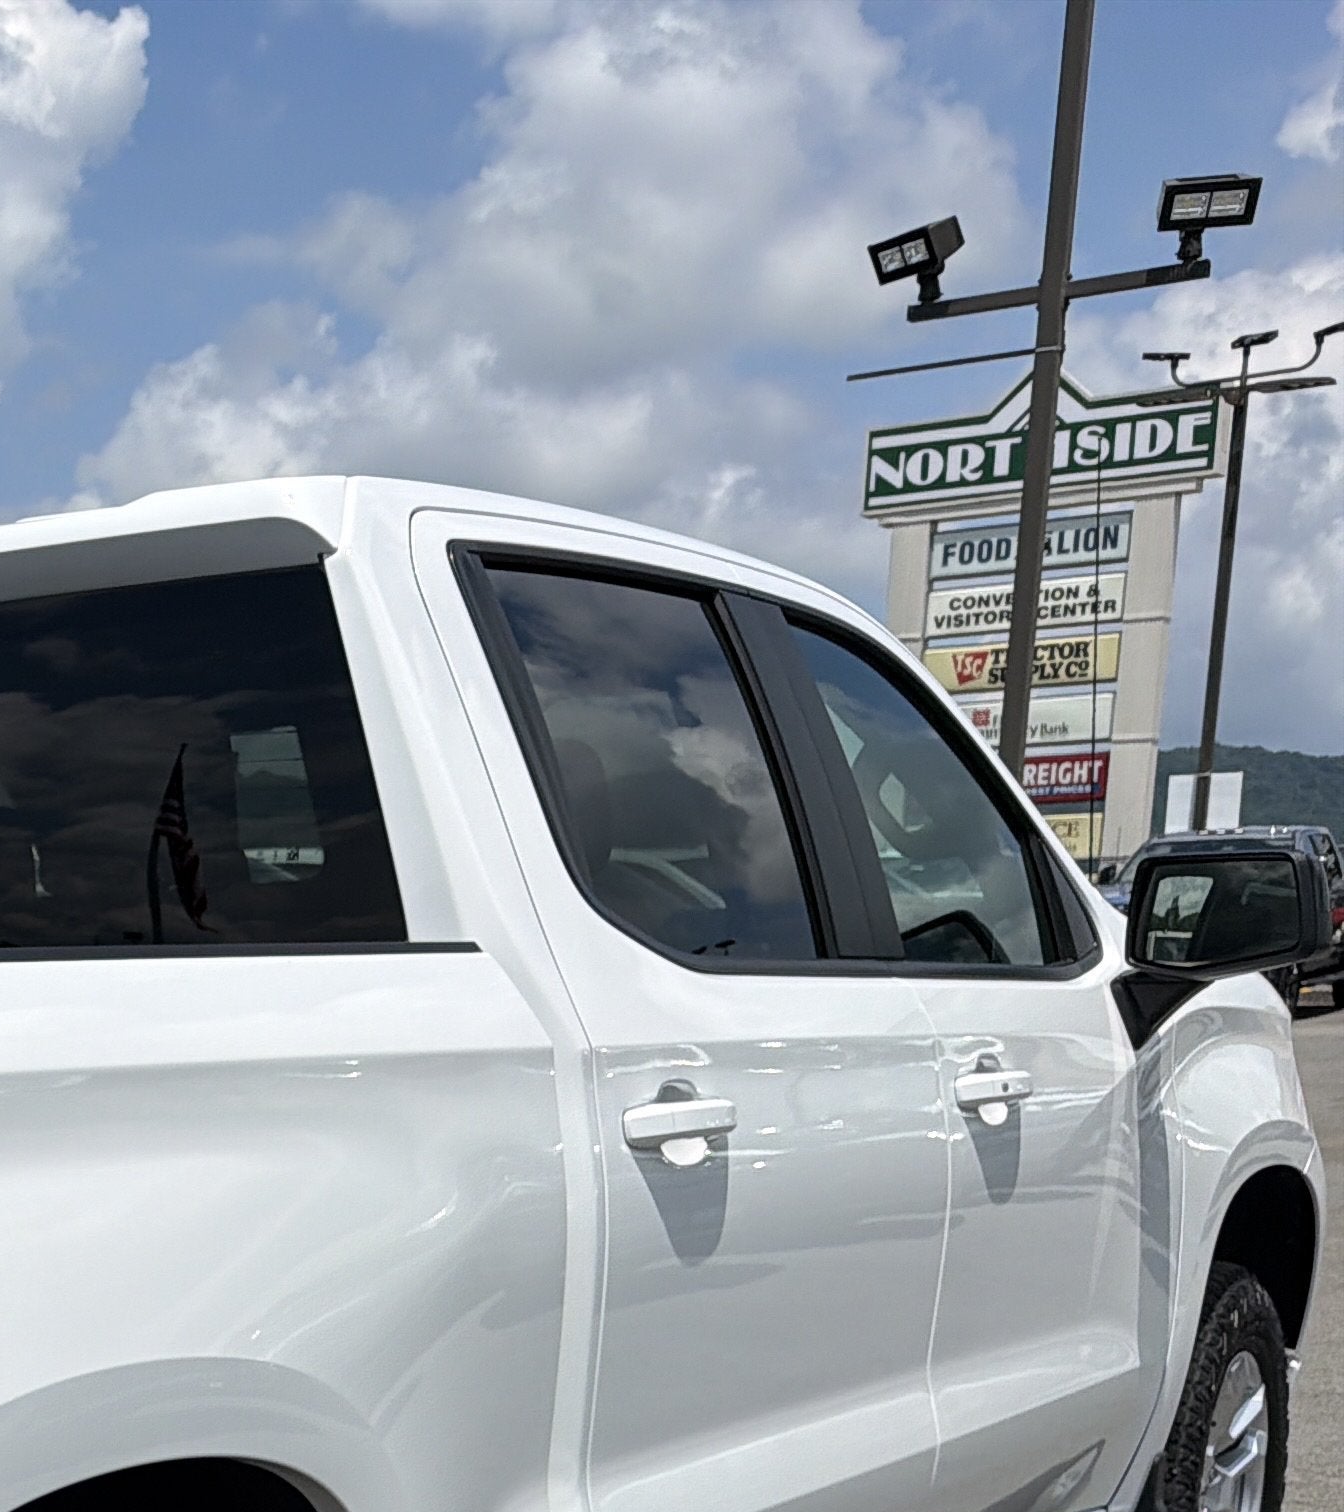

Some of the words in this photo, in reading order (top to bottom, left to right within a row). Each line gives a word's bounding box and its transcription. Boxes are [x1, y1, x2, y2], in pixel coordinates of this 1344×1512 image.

[942, 537, 1012, 567] FOOD
[1056, 525, 1120, 555] LION
[949, 586, 1080, 612] CONVEION
[934, 609, 1013, 629] VISITOR
[1036, 599, 1117, 620] CENTER
[1023, 760, 1104, 787] REIGHT
